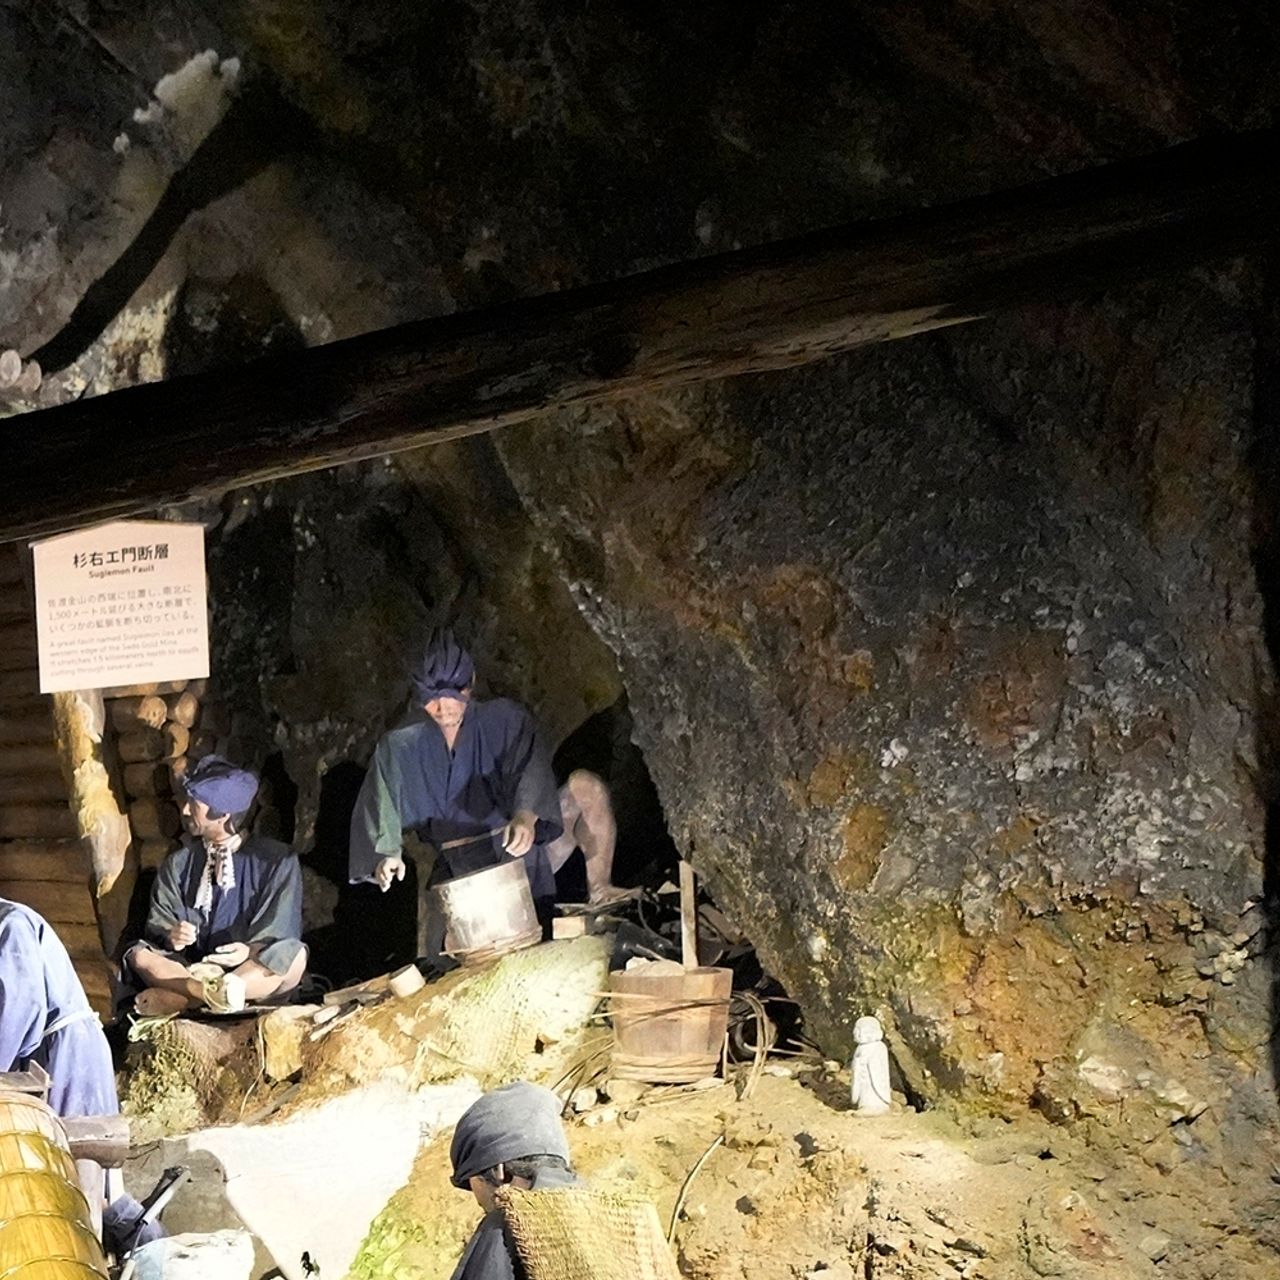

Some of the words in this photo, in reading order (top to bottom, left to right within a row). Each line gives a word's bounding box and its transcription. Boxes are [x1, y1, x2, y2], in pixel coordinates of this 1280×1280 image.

[73, 543, 168, 568] 杉右エ門断層
[132, 564, 155, 574] Fault
